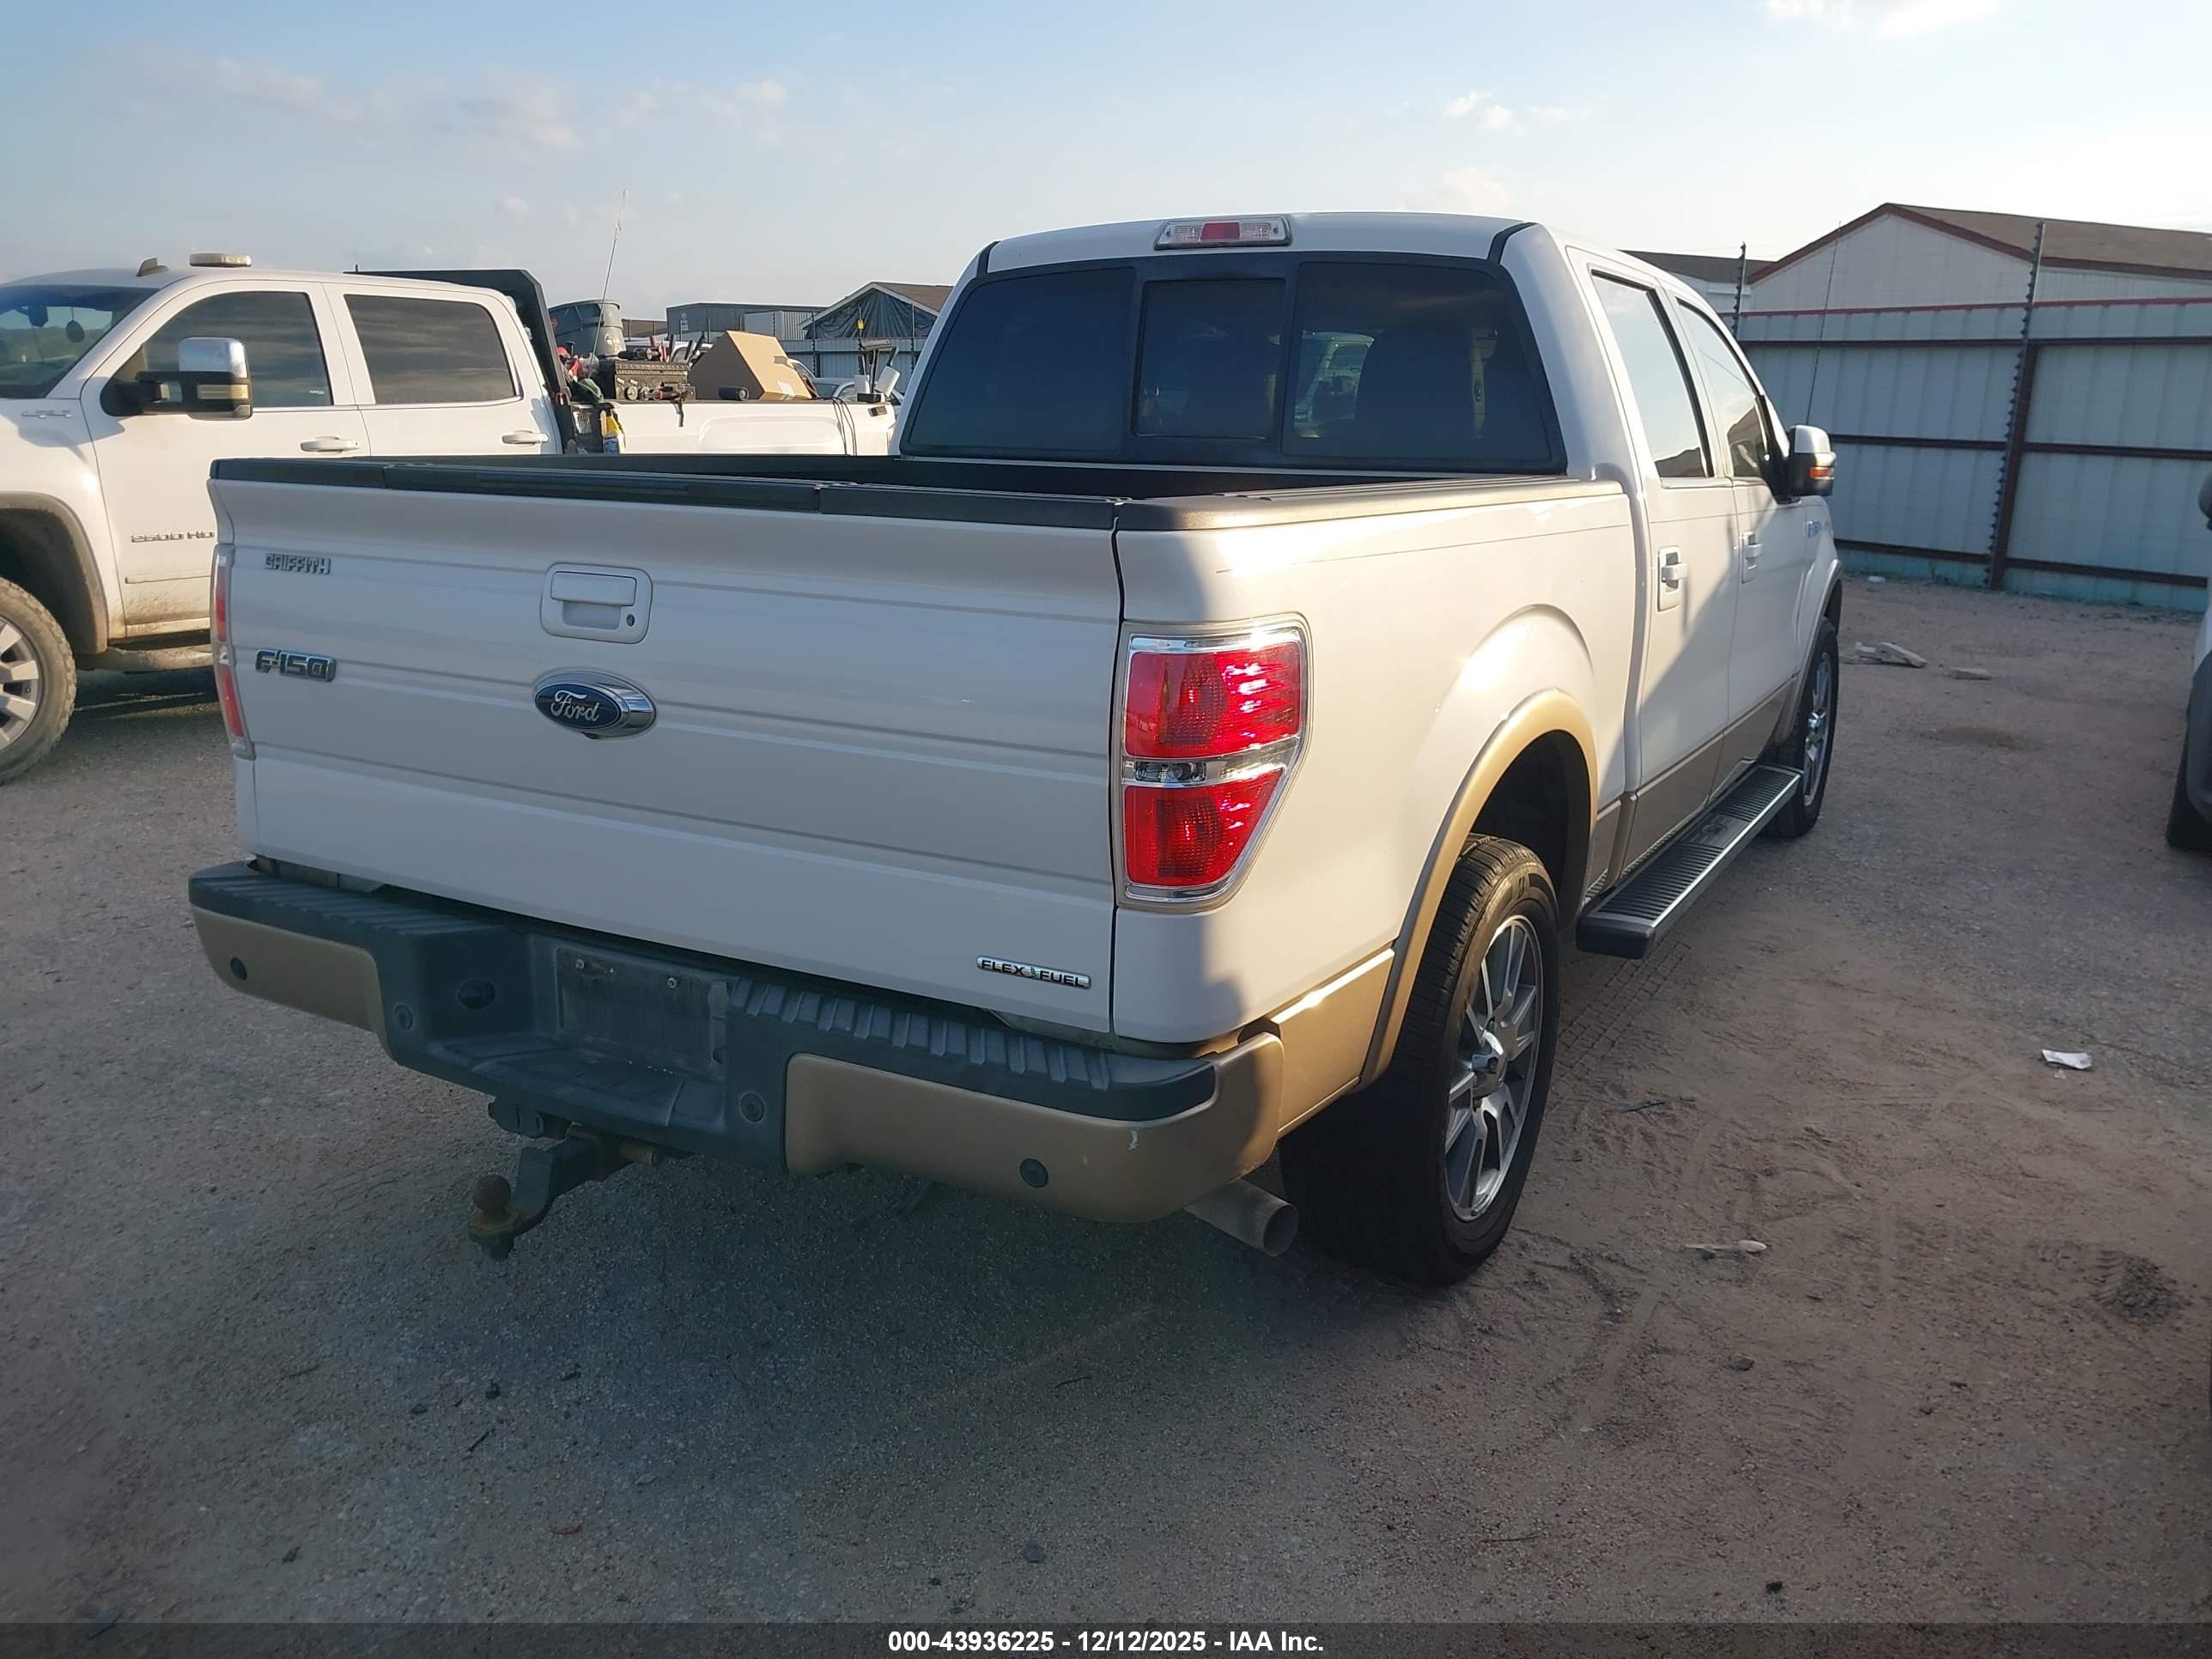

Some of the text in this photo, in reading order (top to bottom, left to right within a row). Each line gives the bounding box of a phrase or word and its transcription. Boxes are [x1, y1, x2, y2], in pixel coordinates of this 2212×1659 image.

[131, 532, 184, 543] 2500
[265, 552, 331, 574] GRIFFITH
[550, 690, 600, 722] Ford
[981, 958, 1085, 988] FLEX FUEL
